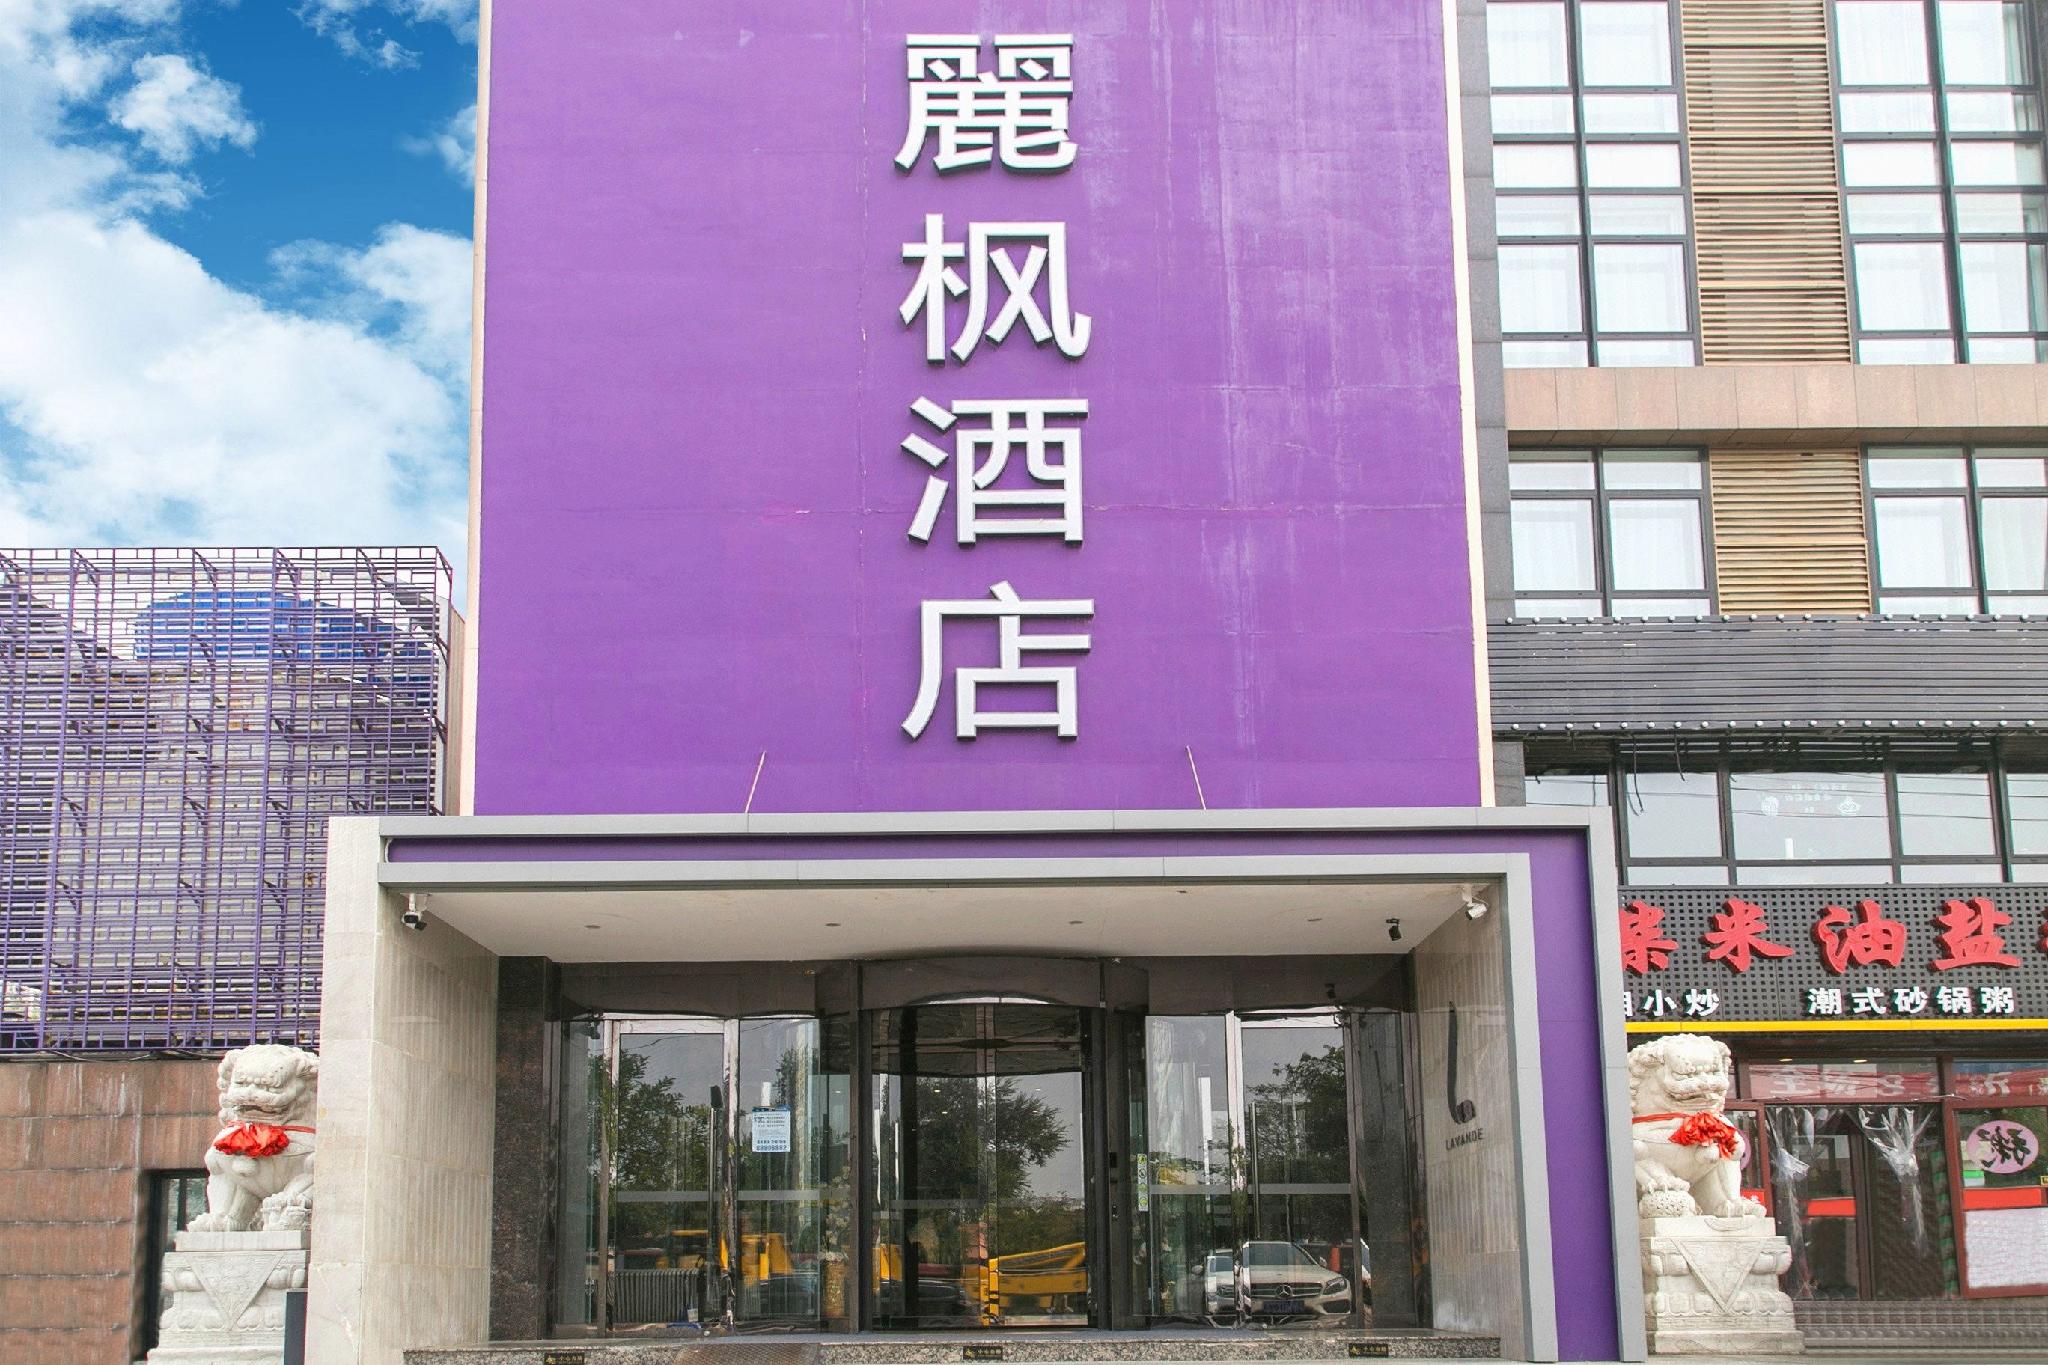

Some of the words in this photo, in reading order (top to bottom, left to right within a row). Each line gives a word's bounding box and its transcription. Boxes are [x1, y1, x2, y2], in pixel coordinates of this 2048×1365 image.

[895, 34, 1094, 739] 麗枫酒店
[1619, 897, 2048, 974] 柴米油盐
[1808, 986, 2015, 1015] 潮式砂锅粥
[1445, 1127, 1484, 1151] LAVANDE
